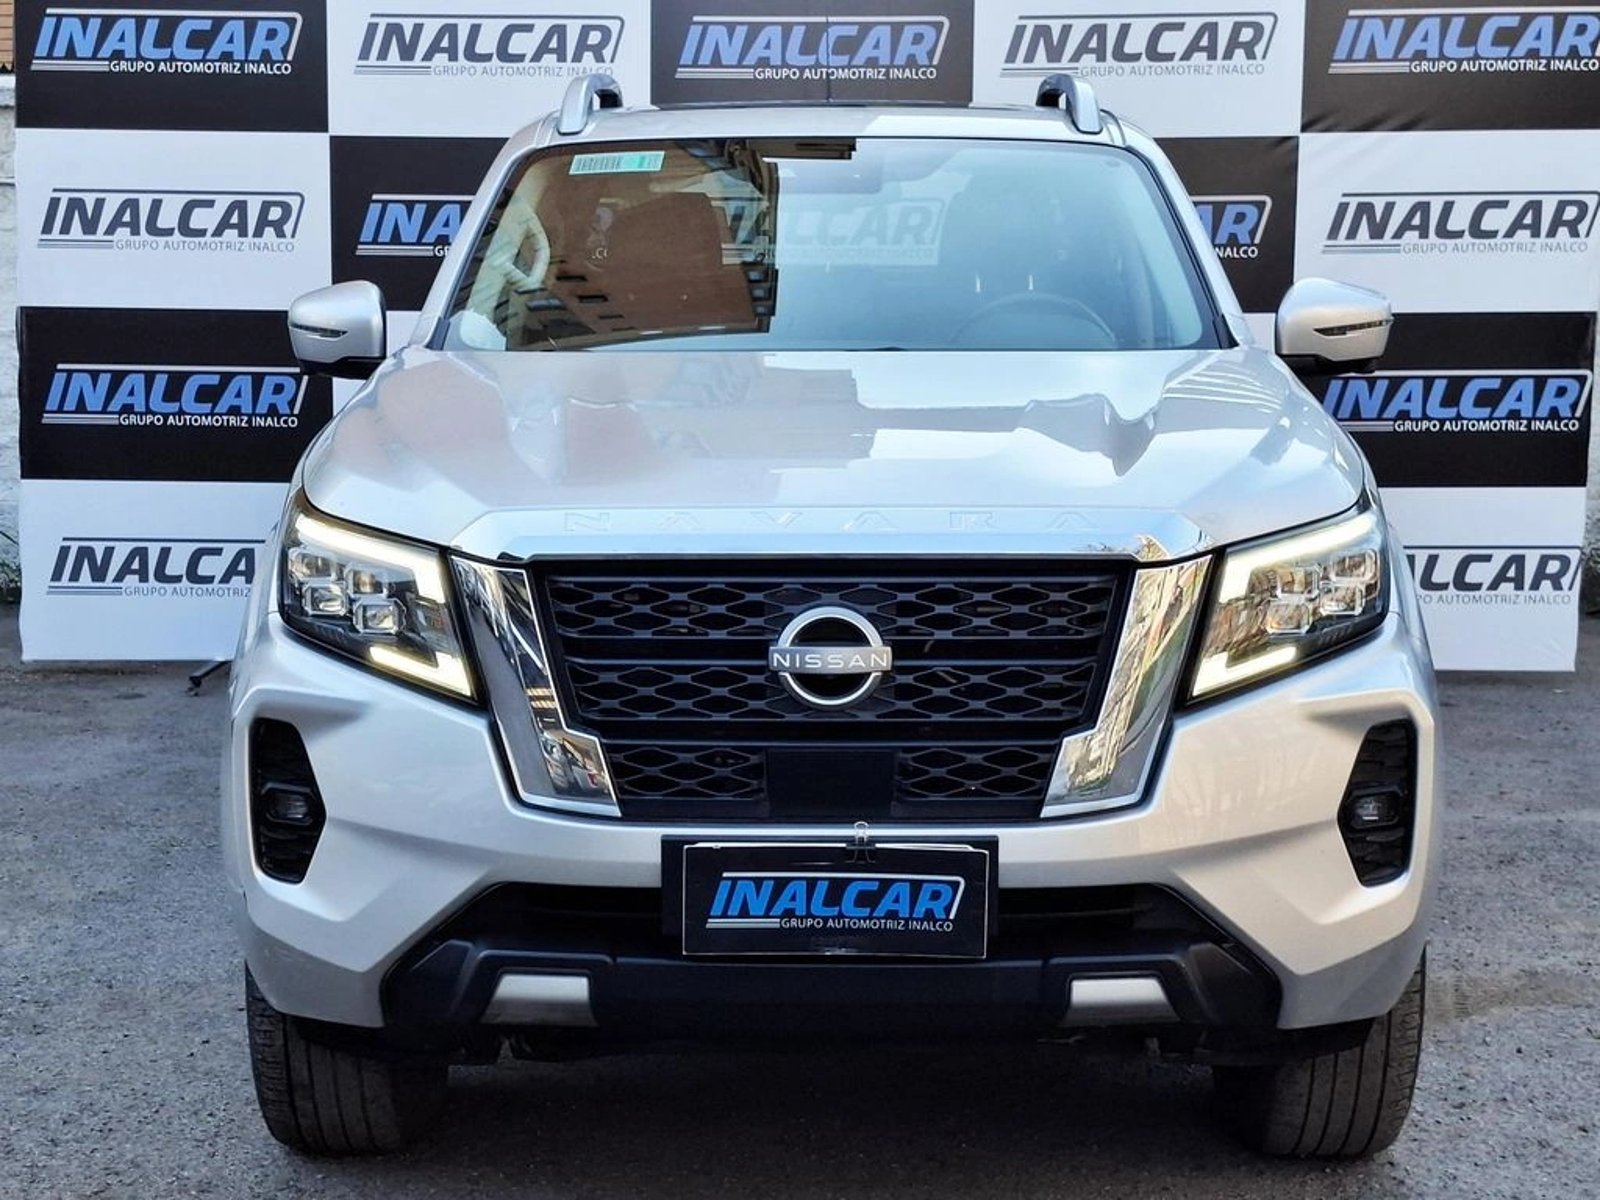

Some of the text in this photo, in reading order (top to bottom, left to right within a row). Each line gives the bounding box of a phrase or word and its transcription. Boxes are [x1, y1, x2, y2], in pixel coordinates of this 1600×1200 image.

[34, 16, 290, 61] INALCAR
[357, 22, 613, 64] INALCAR
[679, 24, 938, 66] INALCAR
[1004, 21, 1265, 64] INALCAR
[1332, 15, 1600, 60] INALCAR
[110, 61, 292, 75] GRUPO AUTOMOTRIZ INALCO
[433, 65, 477, 76] GRUPO
[481, 66, 563, 77] AUTOMOTRIZ
[755, 68, 937, 79] GRUPO AUTOMOTRIZ INALCO
[1080, 64, 1265, 77] GRUPO AUTOMOTRIZ INALCO
[1411, 59, 1599, 73] GRUPO AUTOMOTRIZ INALCO
[40, 197, 293, 239] INALCAR
[1326, 200, 1589, 240] INALCAR
[115, 239, 295, 253] GRUPO AUTOMOTRIZ INALCO
[1214, 246, 1259, 258] NALCO
[1403, 241, 1588, 254] GRUPO AUTOMOTRIZ INALCO
[44, 372, 297, 414] INALCAR
[1323, 378, 1580, 419] INALCAR
[119, 414, 298, 428] GRUPO AUTOMOTRIZ INALCO
[1395, 419, 1579, 432] GRUPO AUTOMOTRIZ INALCO
[563, 511, 1101, 532] NAVARA
[50, 545, 256, 585] INALCA
[1406, 554, 1571, 591] LCAR
[124, 587, 251, 598] GRUPO AUTOMOTRIZ
[1437, 594, 1520, 605] AUTOMOTRIZ
[1524, 594, 1571, 605] INALCO
[773, 653, 887, 668] NISSAN
[710, 880, 953, 919] INALCAR
[781, 918, 953, 932] GRUPO AUTOMOTRIZ INALCO
